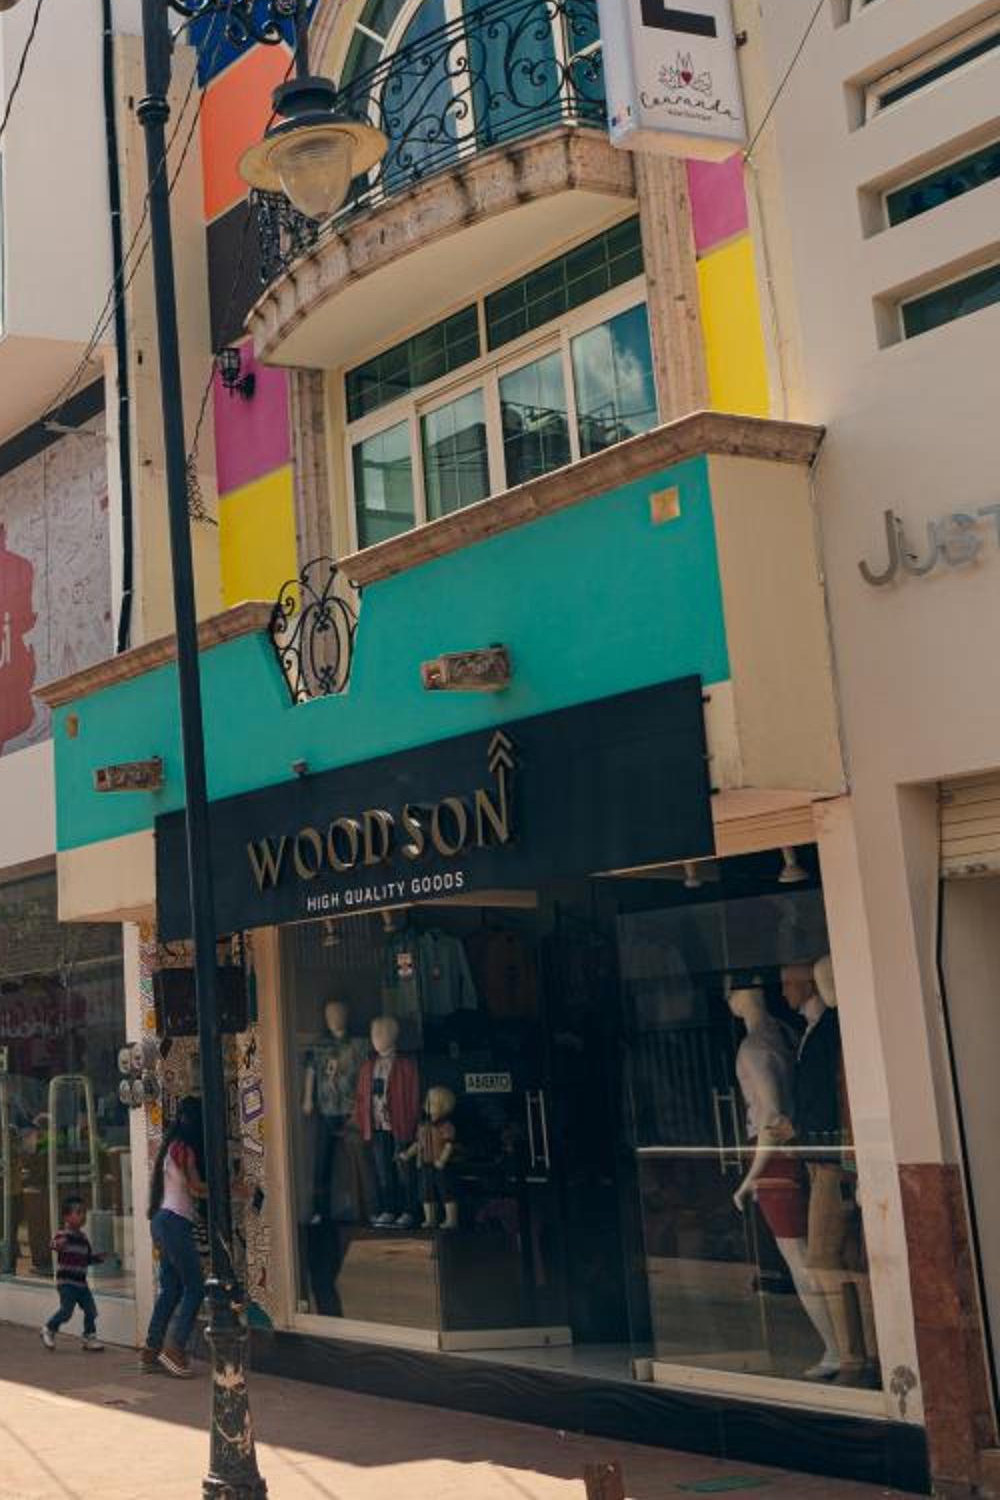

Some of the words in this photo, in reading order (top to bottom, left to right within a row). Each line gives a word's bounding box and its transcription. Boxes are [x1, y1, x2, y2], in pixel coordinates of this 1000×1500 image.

[247, 762, 510, 893] WOODSON
[306, 891, 339, 911] HIGH
[344, 882, 404, 905] QUALITY
[411, 870, 464, 894] GOODS
[467, 1075, 510, 1089] ABIERTO
